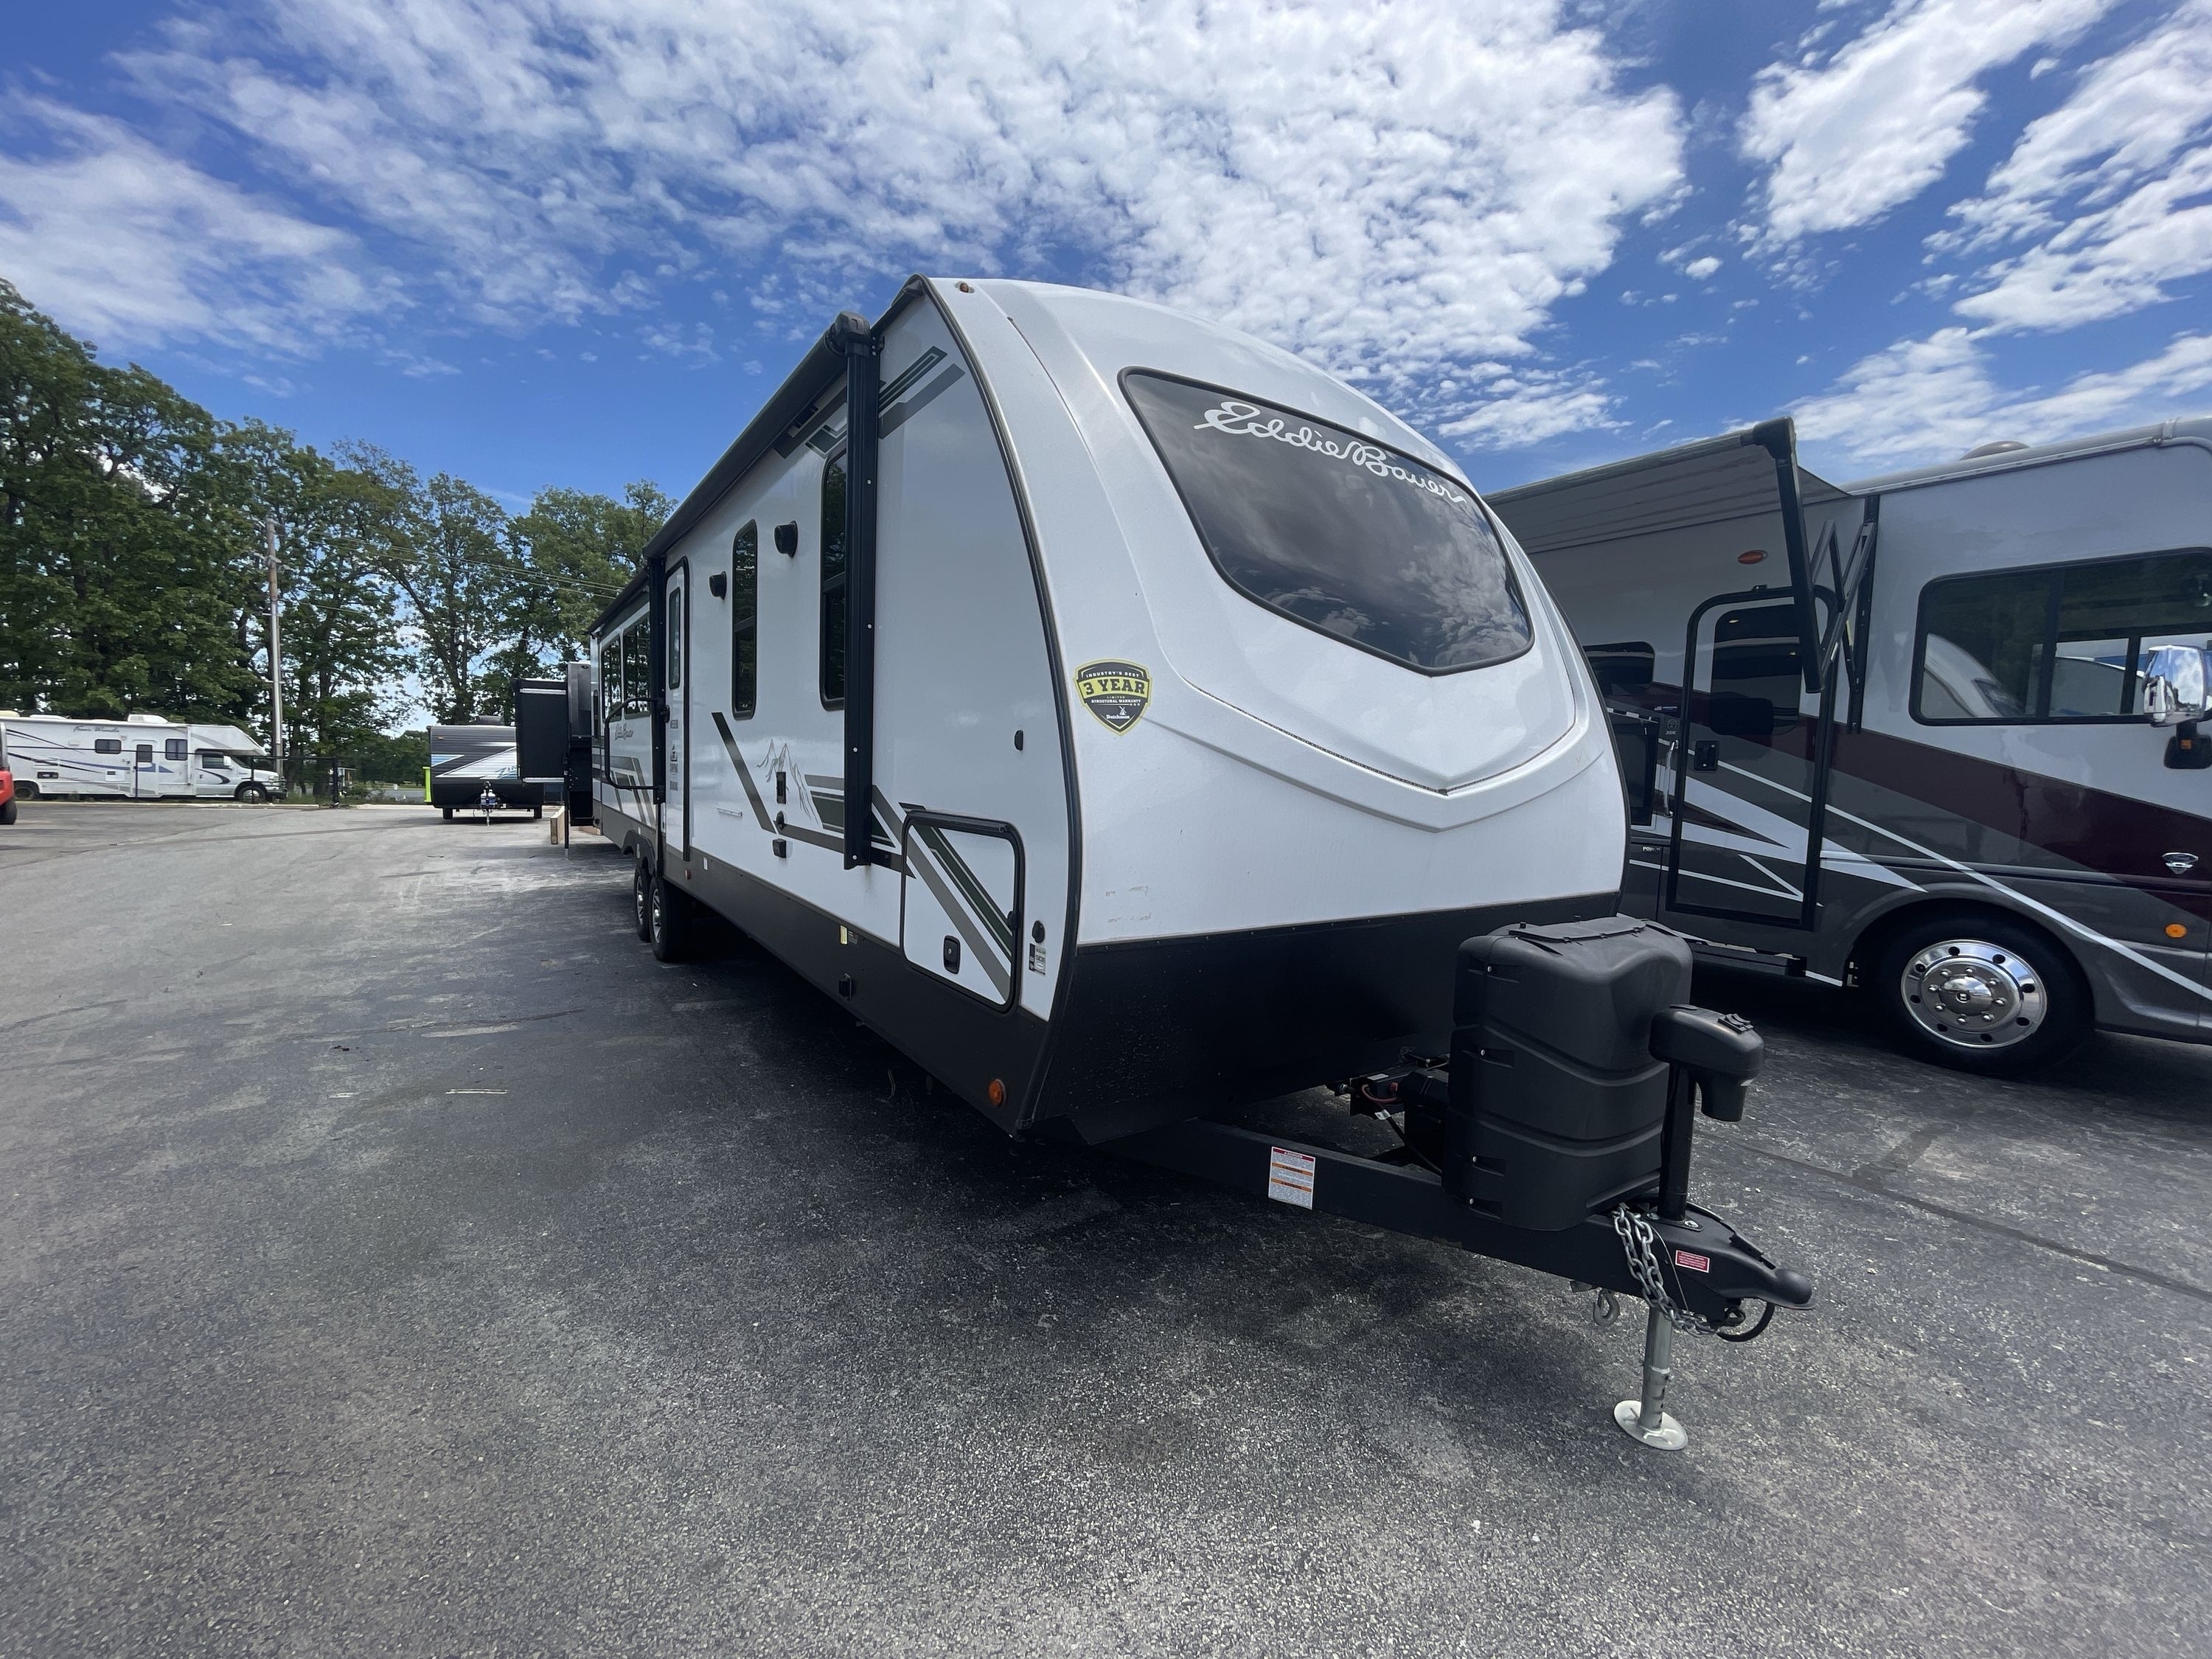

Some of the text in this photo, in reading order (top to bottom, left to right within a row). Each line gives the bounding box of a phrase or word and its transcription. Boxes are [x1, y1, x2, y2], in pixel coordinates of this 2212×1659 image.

[1194, 401, 1467, 503] Eddie Bauer
[1083, 678, 1144, 695] 3 YEAR
